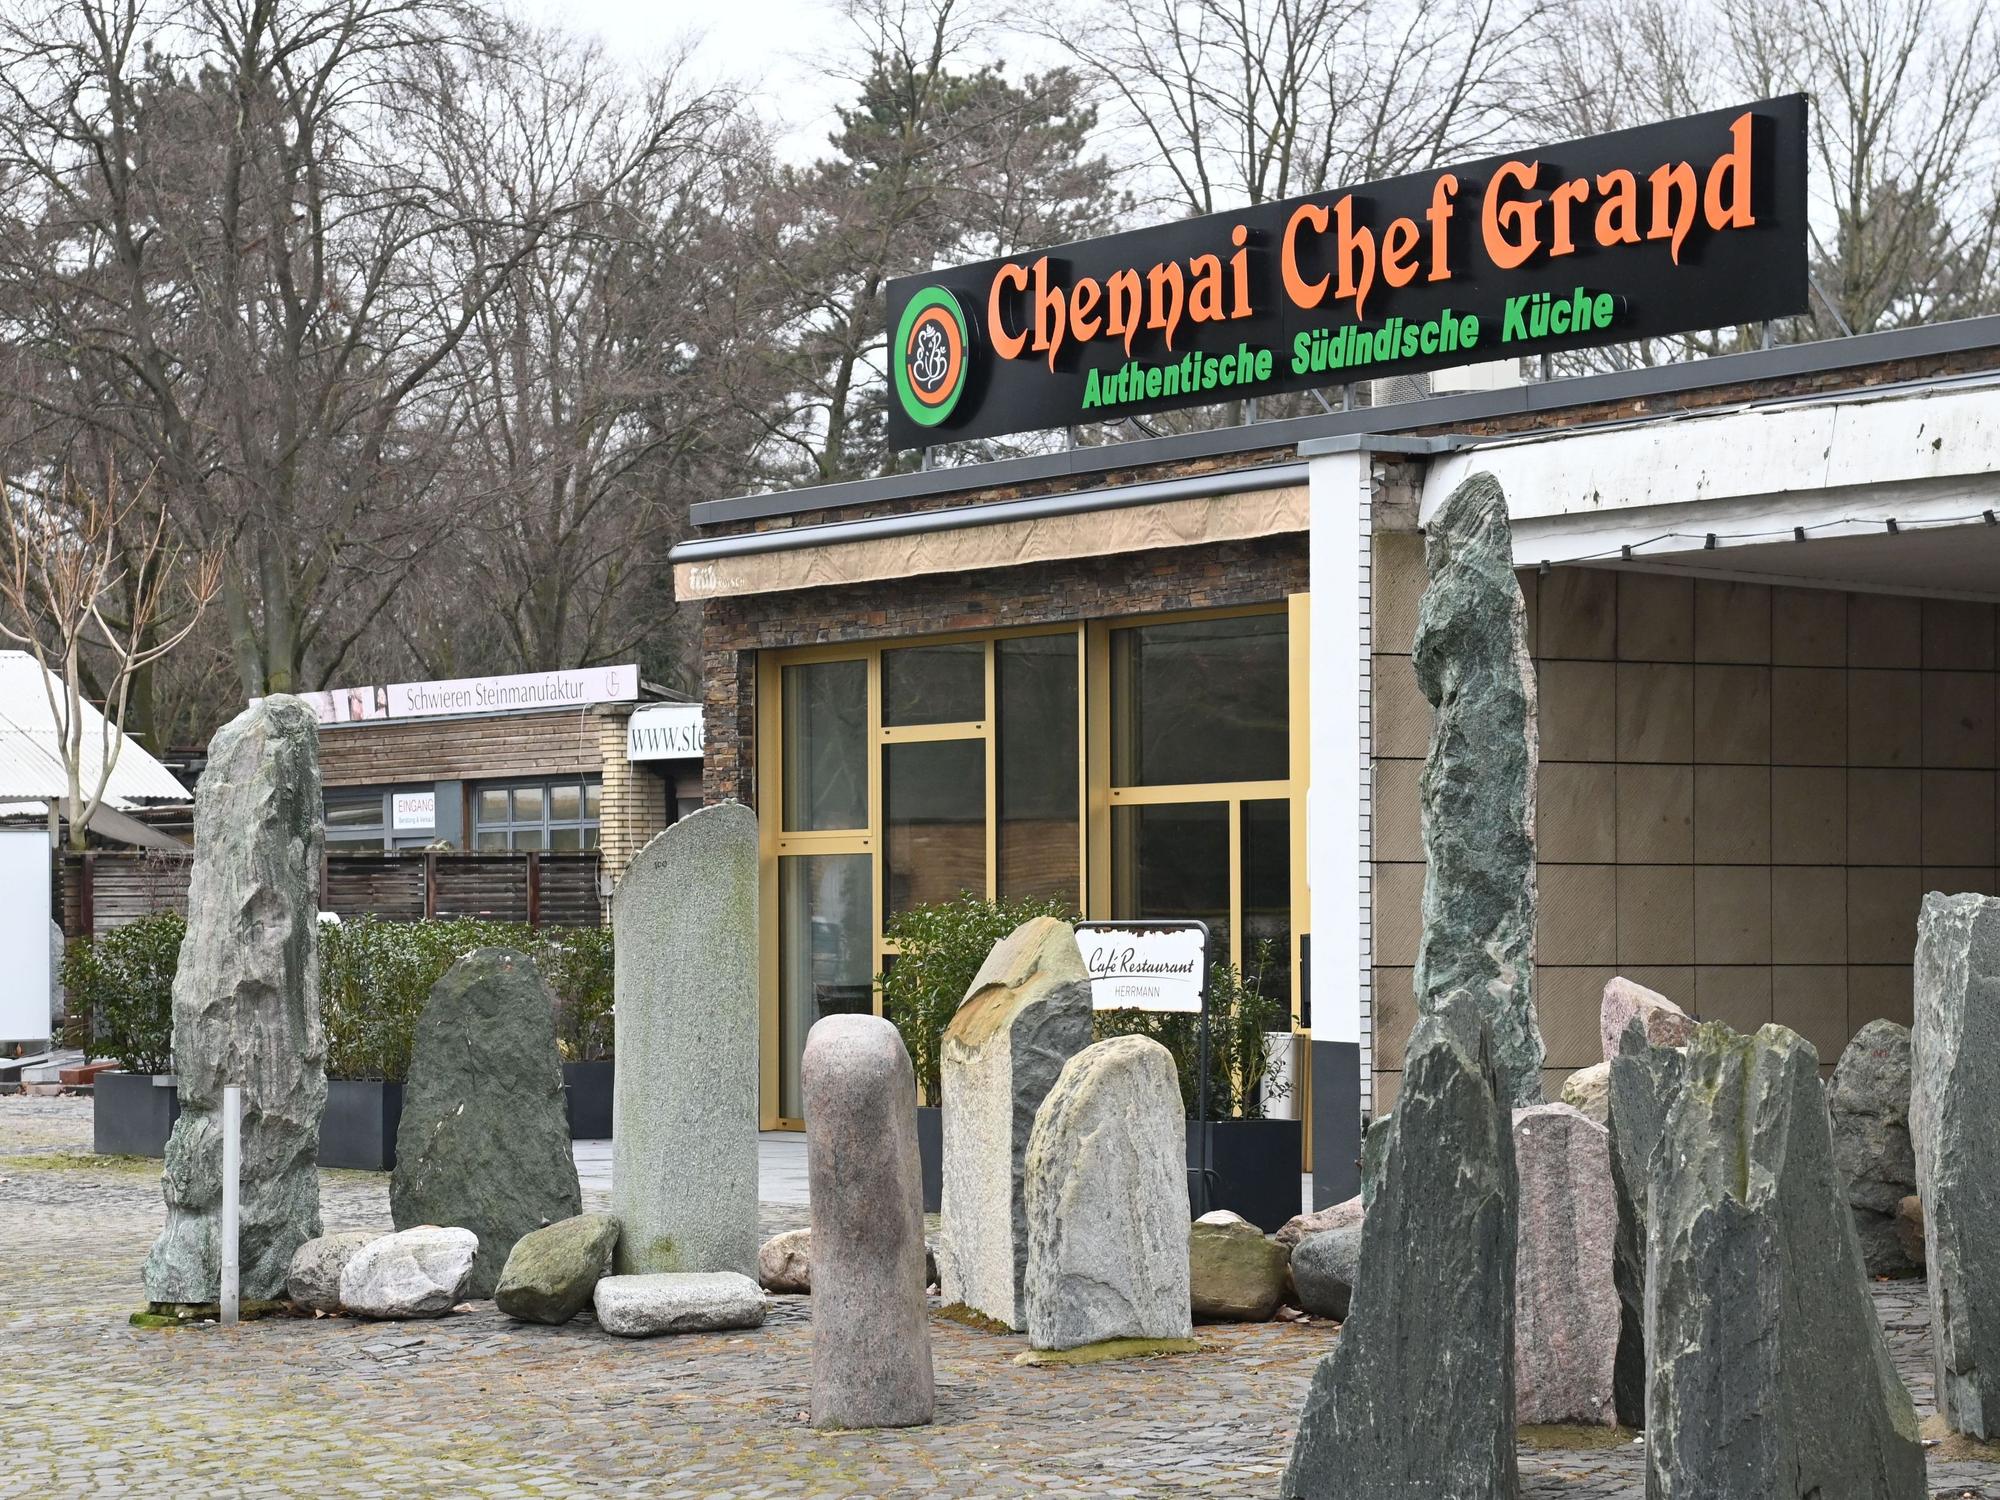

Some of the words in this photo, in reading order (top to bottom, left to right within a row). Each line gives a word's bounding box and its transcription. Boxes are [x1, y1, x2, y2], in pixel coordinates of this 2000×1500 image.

[987, 224, 1254, 372] Chennai
[1281, 173, 1459, 319] Chef
[1482, 111, 1756, 264] Grand
[1081, 342, 1274, 410] Authentische
[1291, 308, 1480, 375] Südindische
[1502, 286, 1615, 343] Küche
[406, 685, 472, 711] Schwieren
[475, 674, 584, 706] Steinmanufaktur
[398, 799, 434, 813] EINGANG
[1088, 947, 1119, 980] Café
[1119, 947, 1195, 974] Restaurant
[1114, 984, 1161, 999] HERRMANN
